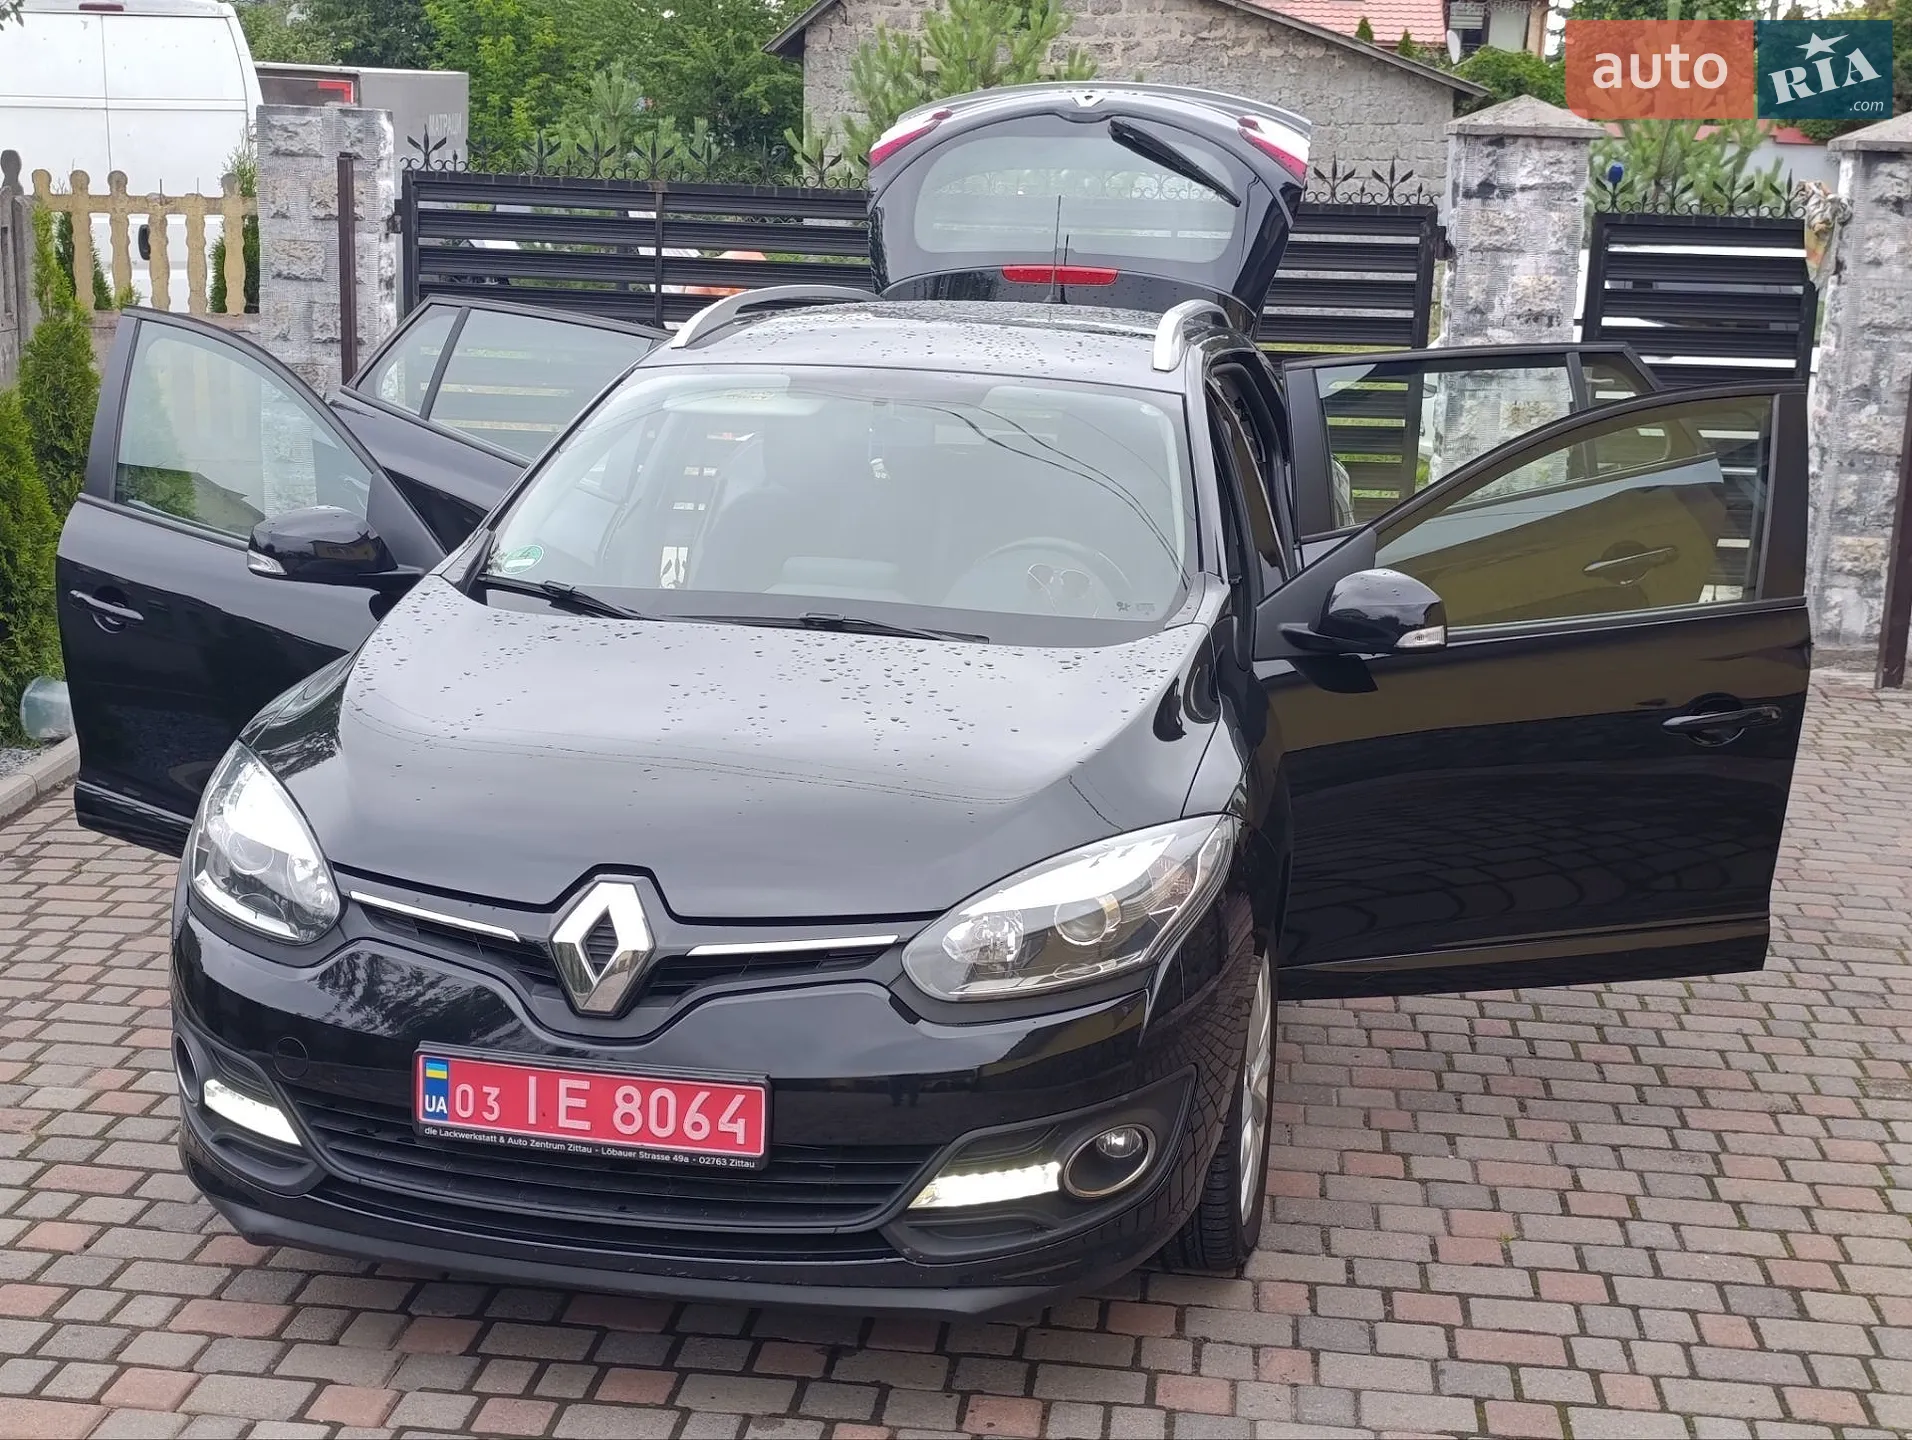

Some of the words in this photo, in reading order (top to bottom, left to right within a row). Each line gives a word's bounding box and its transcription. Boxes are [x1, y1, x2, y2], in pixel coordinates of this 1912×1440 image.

[424, 1094, 448, 1114] UA
[454, 1083, 501, 1122] 03
[528, 1076, 591, 1131] IE
[612, 1085, 747, 1145] 8064
[424, 1127, 438, 1136] die
[439, 1128, 497, 1143] Lackwerkstatt
[499, 1135, 505, 1143] &
[507, 1137, 528, 1146] Auto
[529, 1139, 566, 1151] Zentrum
[567, 1143, 592, 1154] Zittau
[601, 1146, 637, 1158] Löbauer
[638, 1151, 671, 1161] Strasse
[672, 1154, 690, 1163] 49a
[698, 1156, 727, 1166] 02763
[729, 1159, 755, 1168] Zittau
